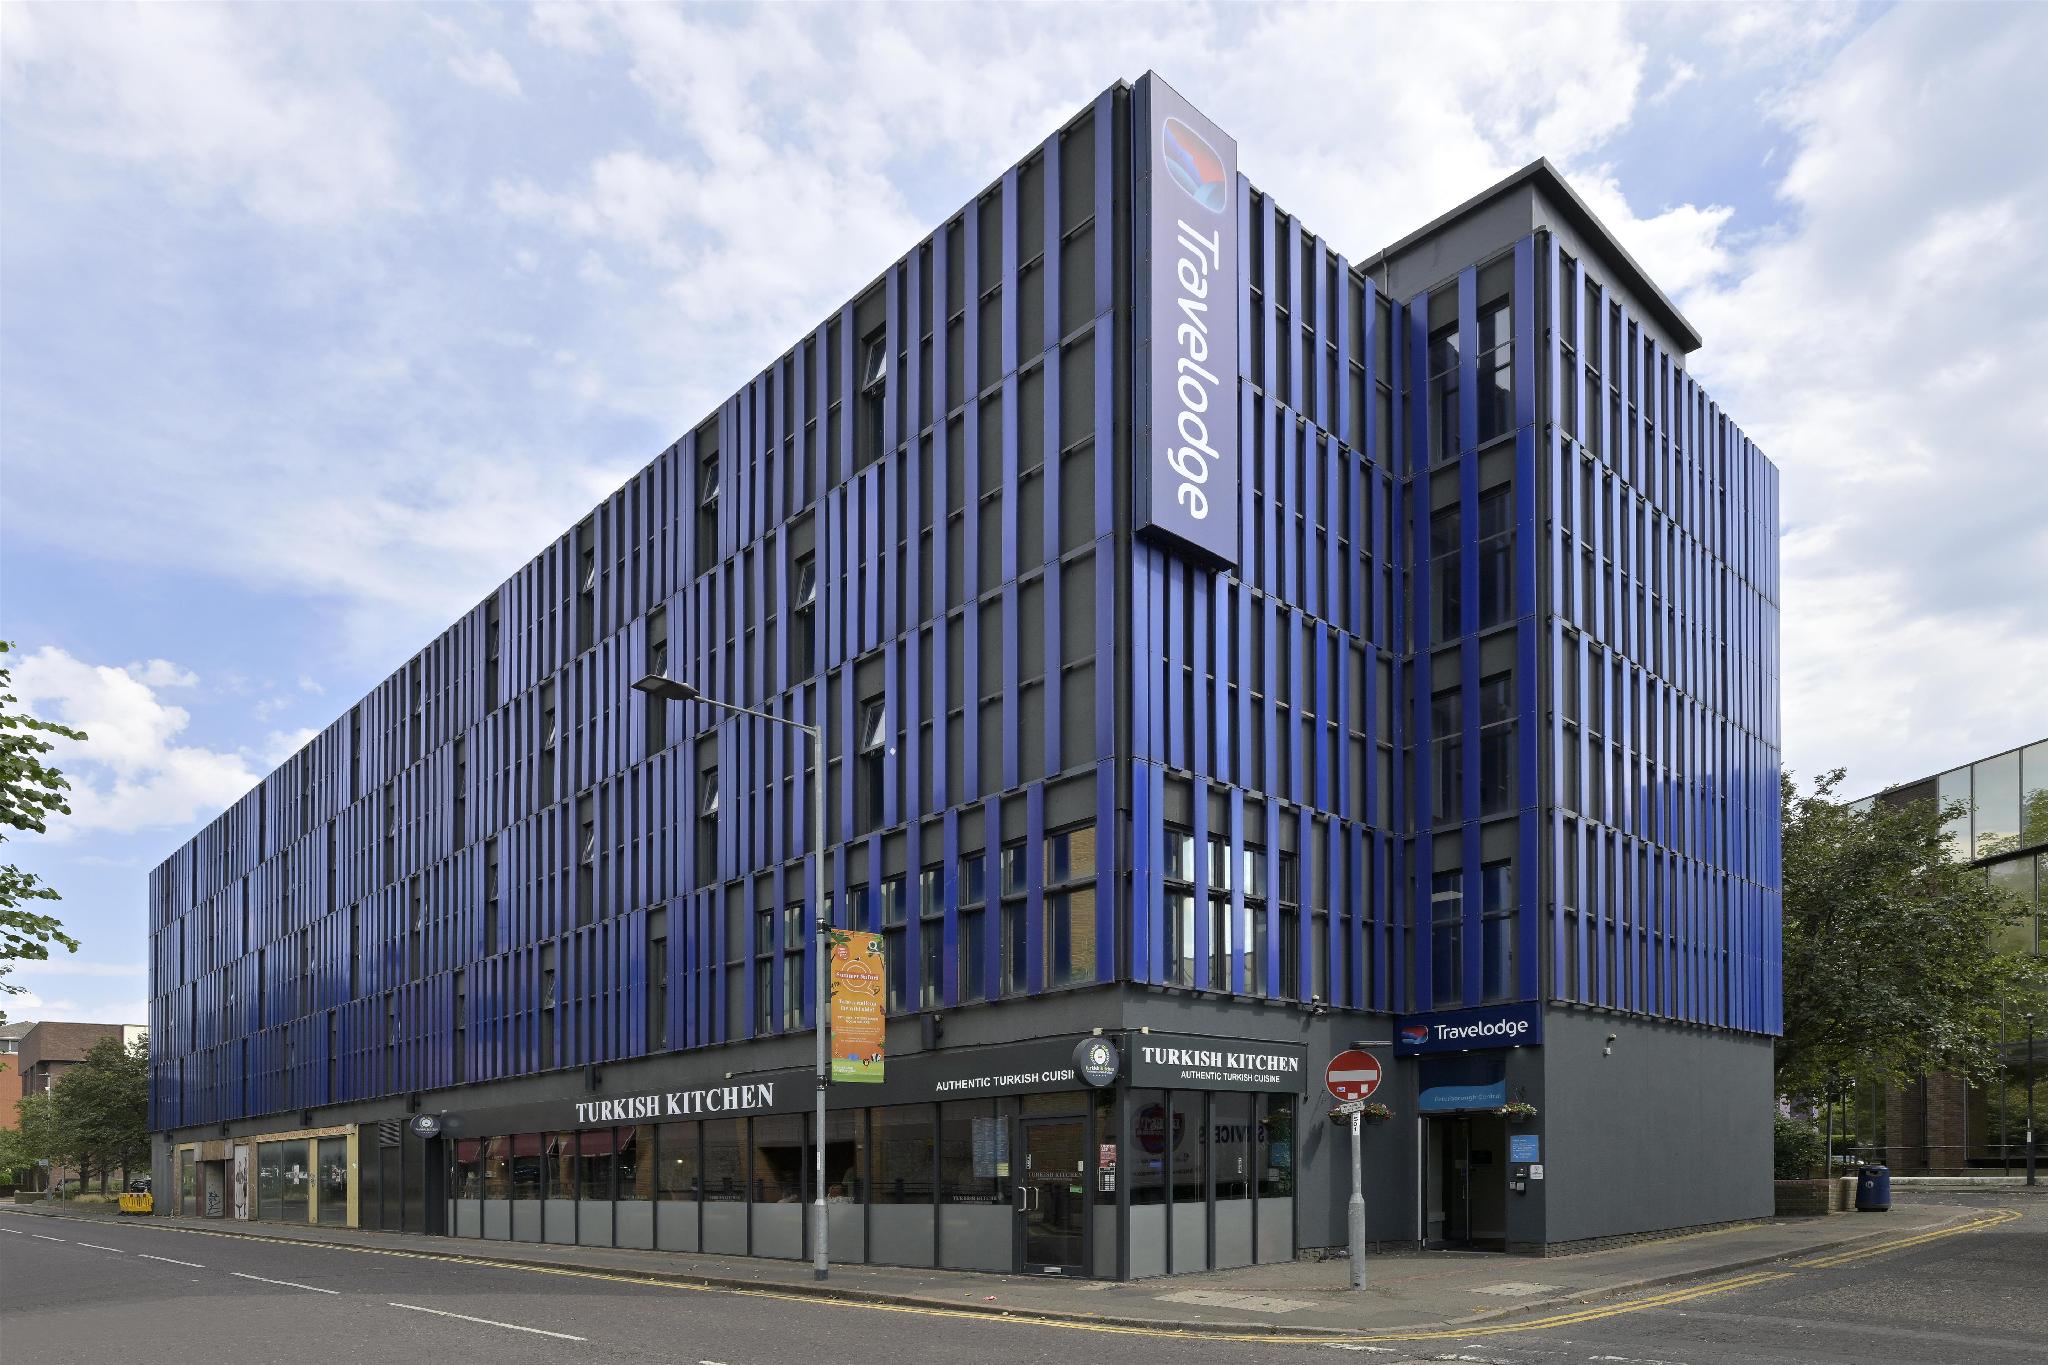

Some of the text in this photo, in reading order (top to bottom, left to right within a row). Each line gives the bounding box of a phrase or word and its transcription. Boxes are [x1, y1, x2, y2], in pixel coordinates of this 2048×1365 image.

[1167, 218, 1220, 521] Travelodge
[1433, 1018, 1529, 1040] Travelodge
[1142, 1046, 1299, 1072] TURKISH KITCHEN
[936, 1069, 1075, 1092] AUTHENTIC TURKISH CUISI
[1181, 1070, 1281, 1083] AUTHENTIC TURKISH CUISINE
[575, 1082, 774, 1123] TURKISH KITCHEN
